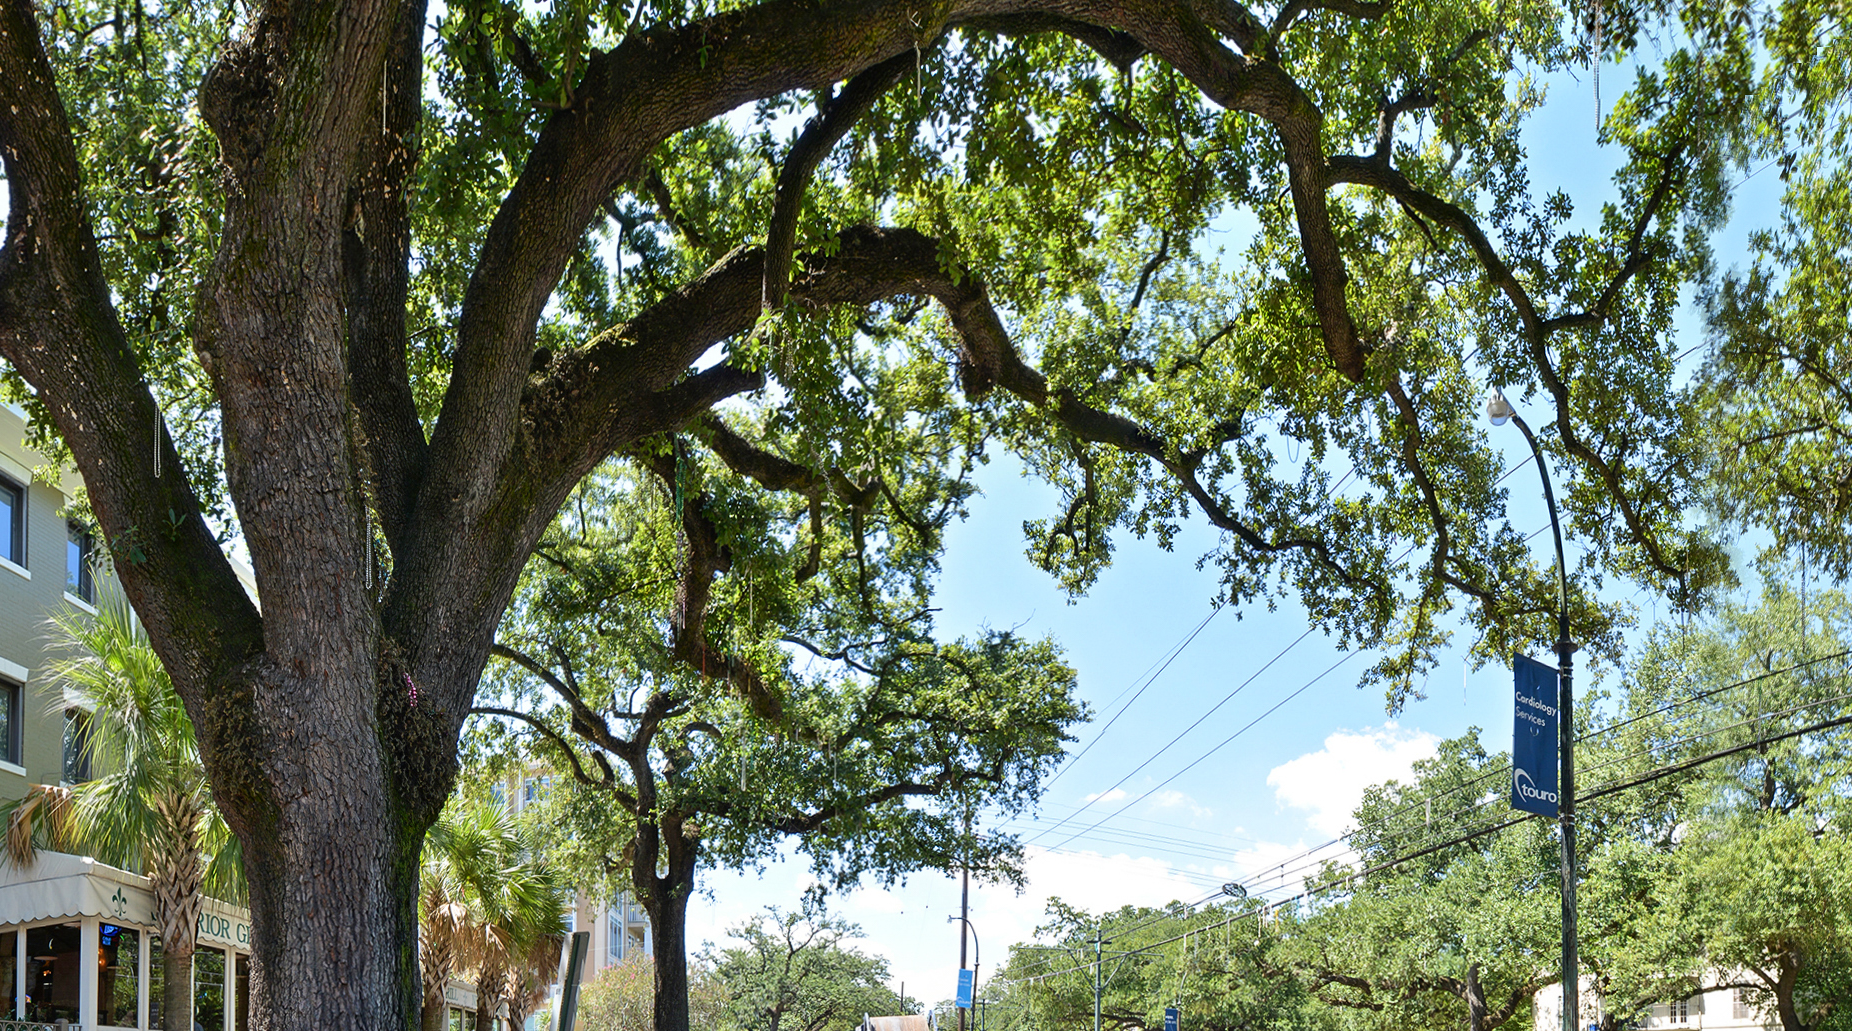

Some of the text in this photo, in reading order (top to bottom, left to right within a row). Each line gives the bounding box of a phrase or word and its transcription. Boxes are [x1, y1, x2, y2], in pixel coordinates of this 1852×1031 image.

[1515, 690, 1558, 717] Cardiology
[1515, 705, 1546, 727] Services
[1521, 784, 1557, 803] touro
